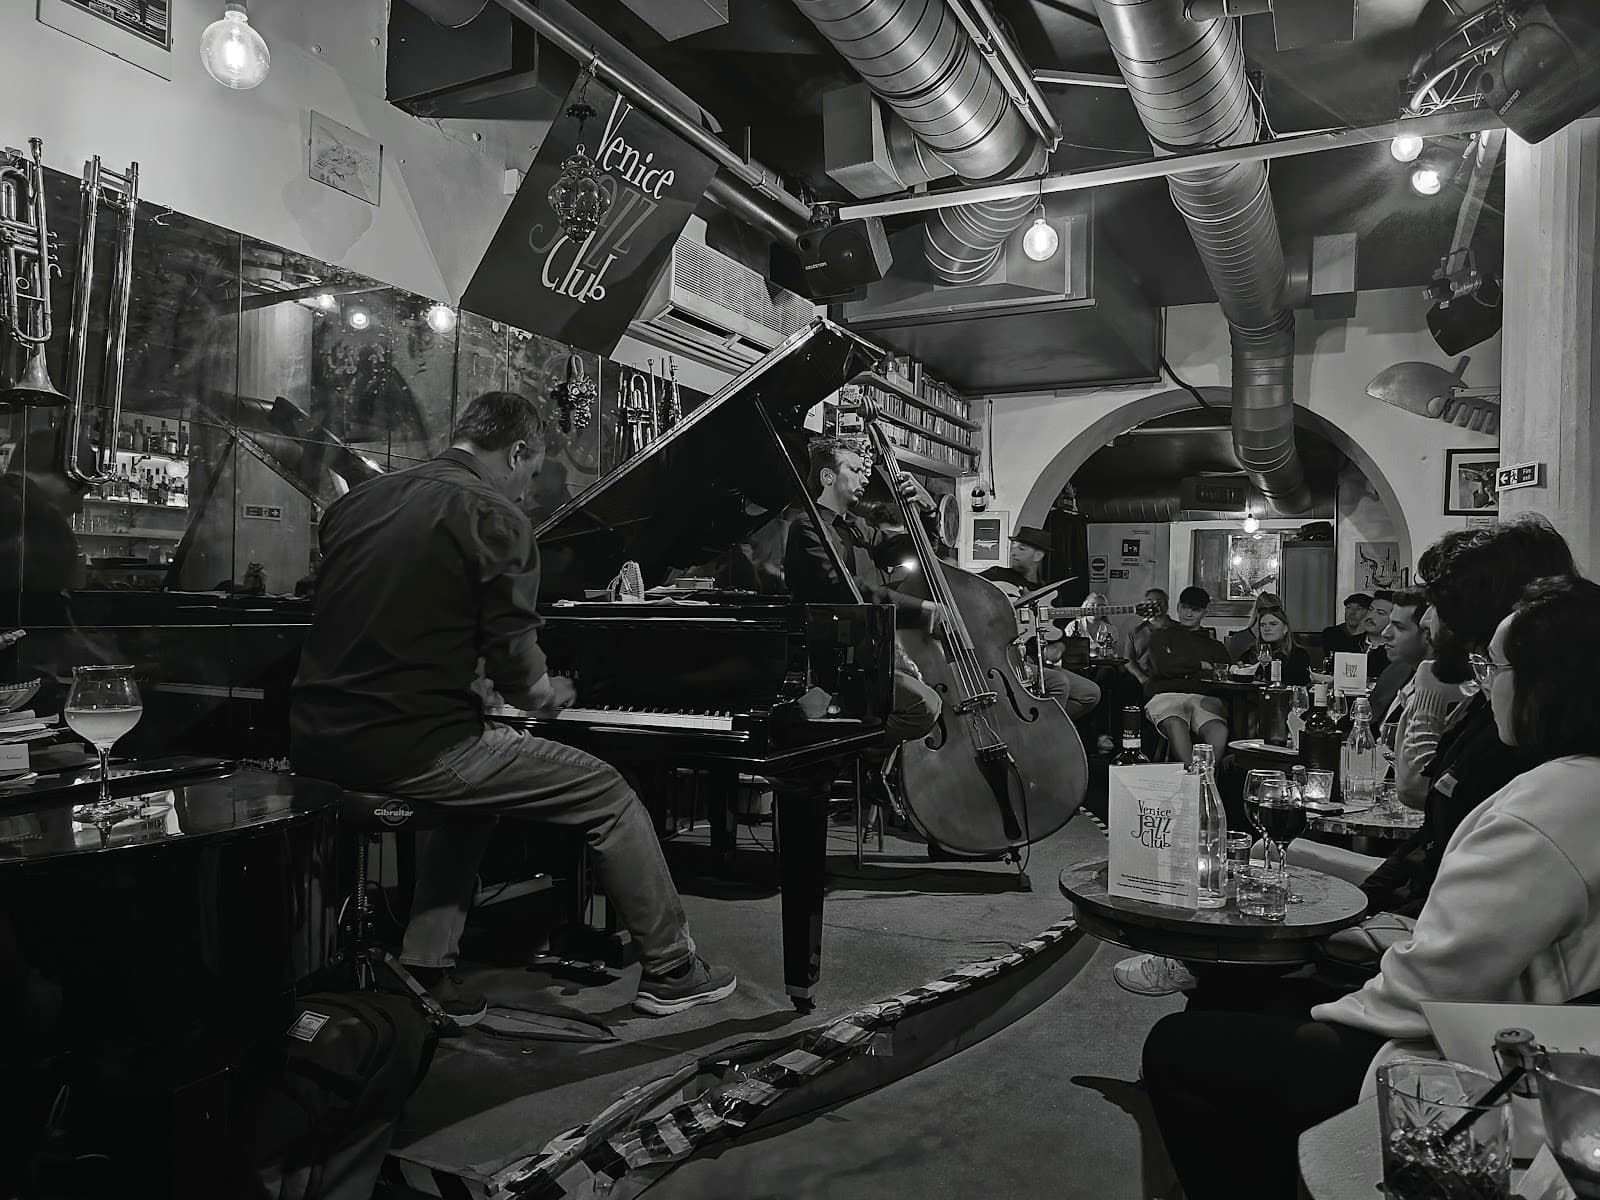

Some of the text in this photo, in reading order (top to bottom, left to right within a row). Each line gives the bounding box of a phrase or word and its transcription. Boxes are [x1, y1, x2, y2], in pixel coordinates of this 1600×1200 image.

[595, 91, 675, 200] Venice
[541, 230, 618, 304] Club
[374, 808, 414, 817] Gibraltar
[1138, 799, 1172, 817] Venice
[1130, 814, 1172, 840] Jazz
[1141, 829, 1171, 849] Club
